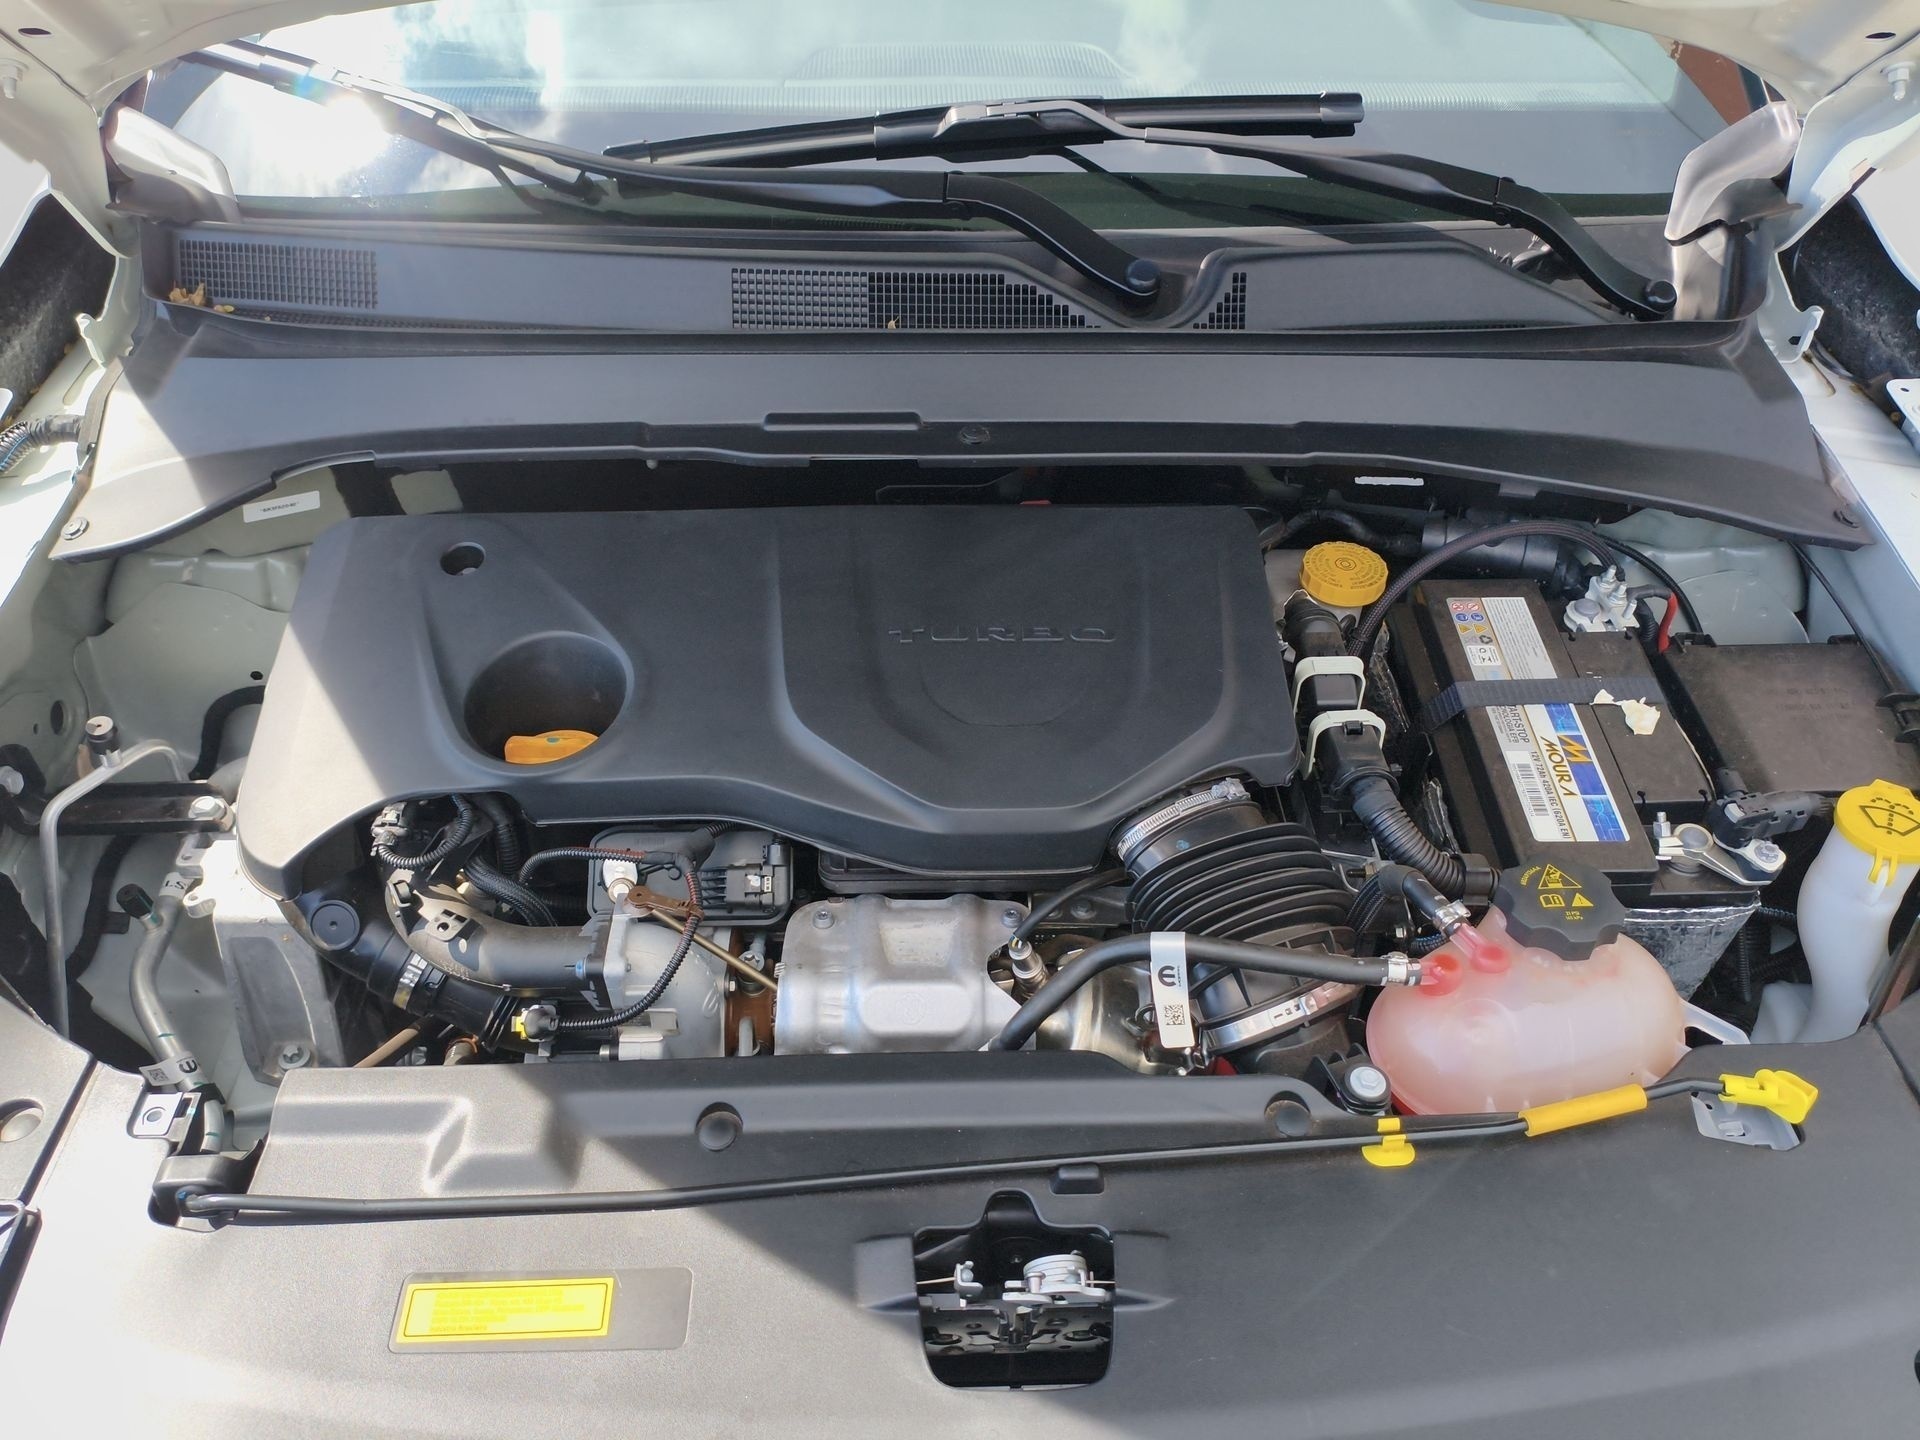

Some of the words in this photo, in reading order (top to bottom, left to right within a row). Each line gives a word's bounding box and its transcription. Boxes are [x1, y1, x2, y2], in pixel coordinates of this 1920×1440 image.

[888, 626, 1116, 643] TURBO
[1509, 704, 1530, 743] TART-STOP
[1531, 751, 1541, 762] 12V
[1536, 763, 1547, 779] 72Ah
[1548, 796, 1559, 807] IEC
[1541, 735, 1578, 796] MOURA
